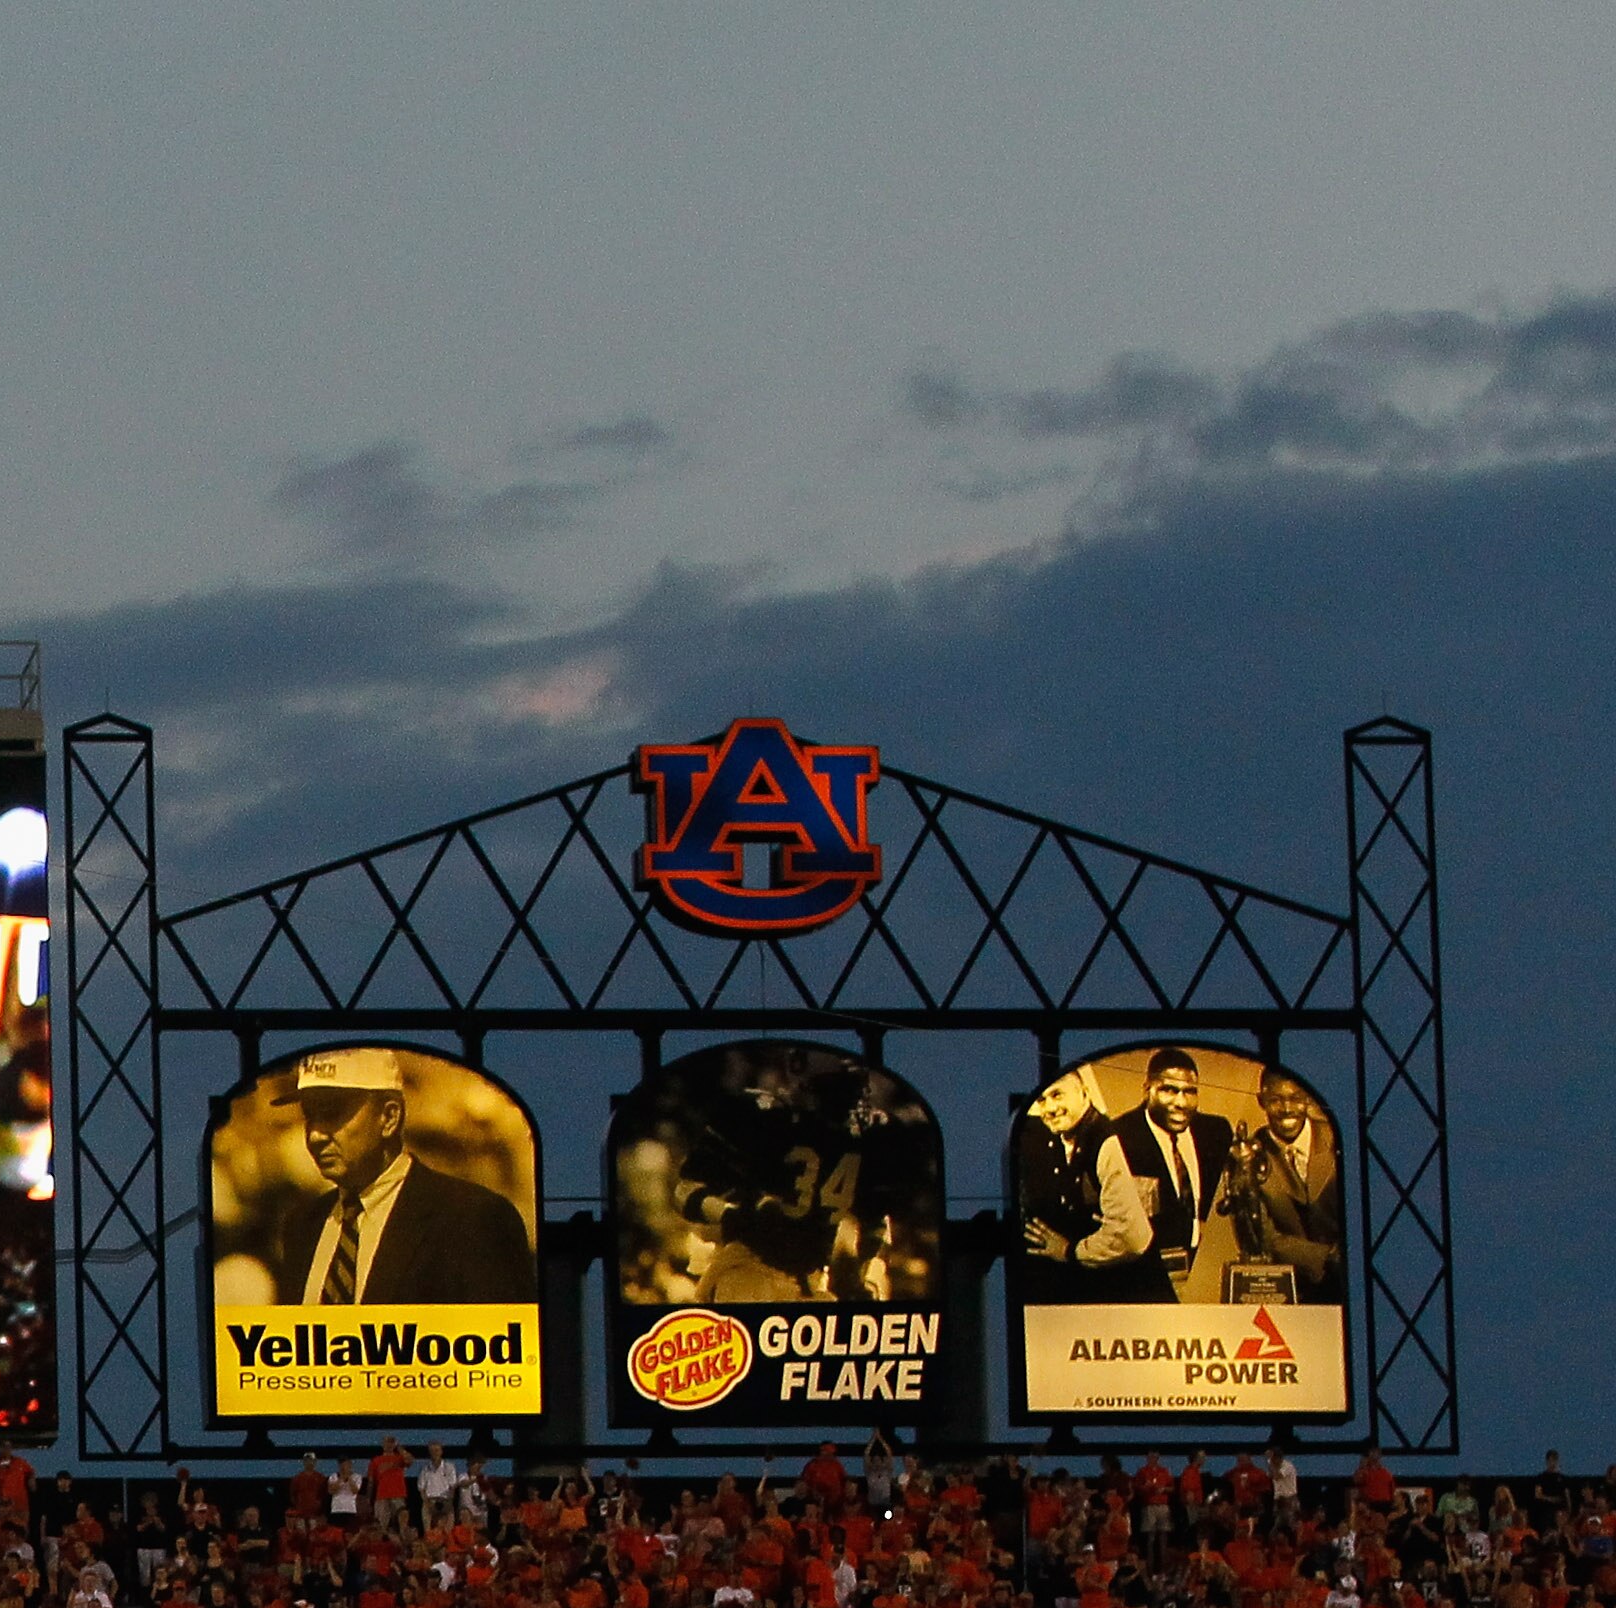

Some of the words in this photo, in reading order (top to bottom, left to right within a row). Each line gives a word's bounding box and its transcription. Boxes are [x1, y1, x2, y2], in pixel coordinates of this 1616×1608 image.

[784, 1146, 861, 1225] 34
[226, 1322, 523, 1367] YellaWood
[639, 1317, 734, 1374] GOLDEN
[759, 1313, 940, 1357] GOLDEN
[1068, 1338, 1227, 1361] ALABAMA
[238, 1371, 353, 1391] Pressure
[361, 1370, 459, 1389] Treated
[469, 1369, 522, 1388] Pine
[654, 1347, 737, 1400] FLAKE
[780, 1359, 925, 1401] FLAKE
[1184, 1362, 1299, 1385] POWER
[1073, 1397, 1081, 1408] A
[1086, 1397, 1163, 1408] SOUTHERN
[1167, 1395, 1237, 1407] COMPANY
